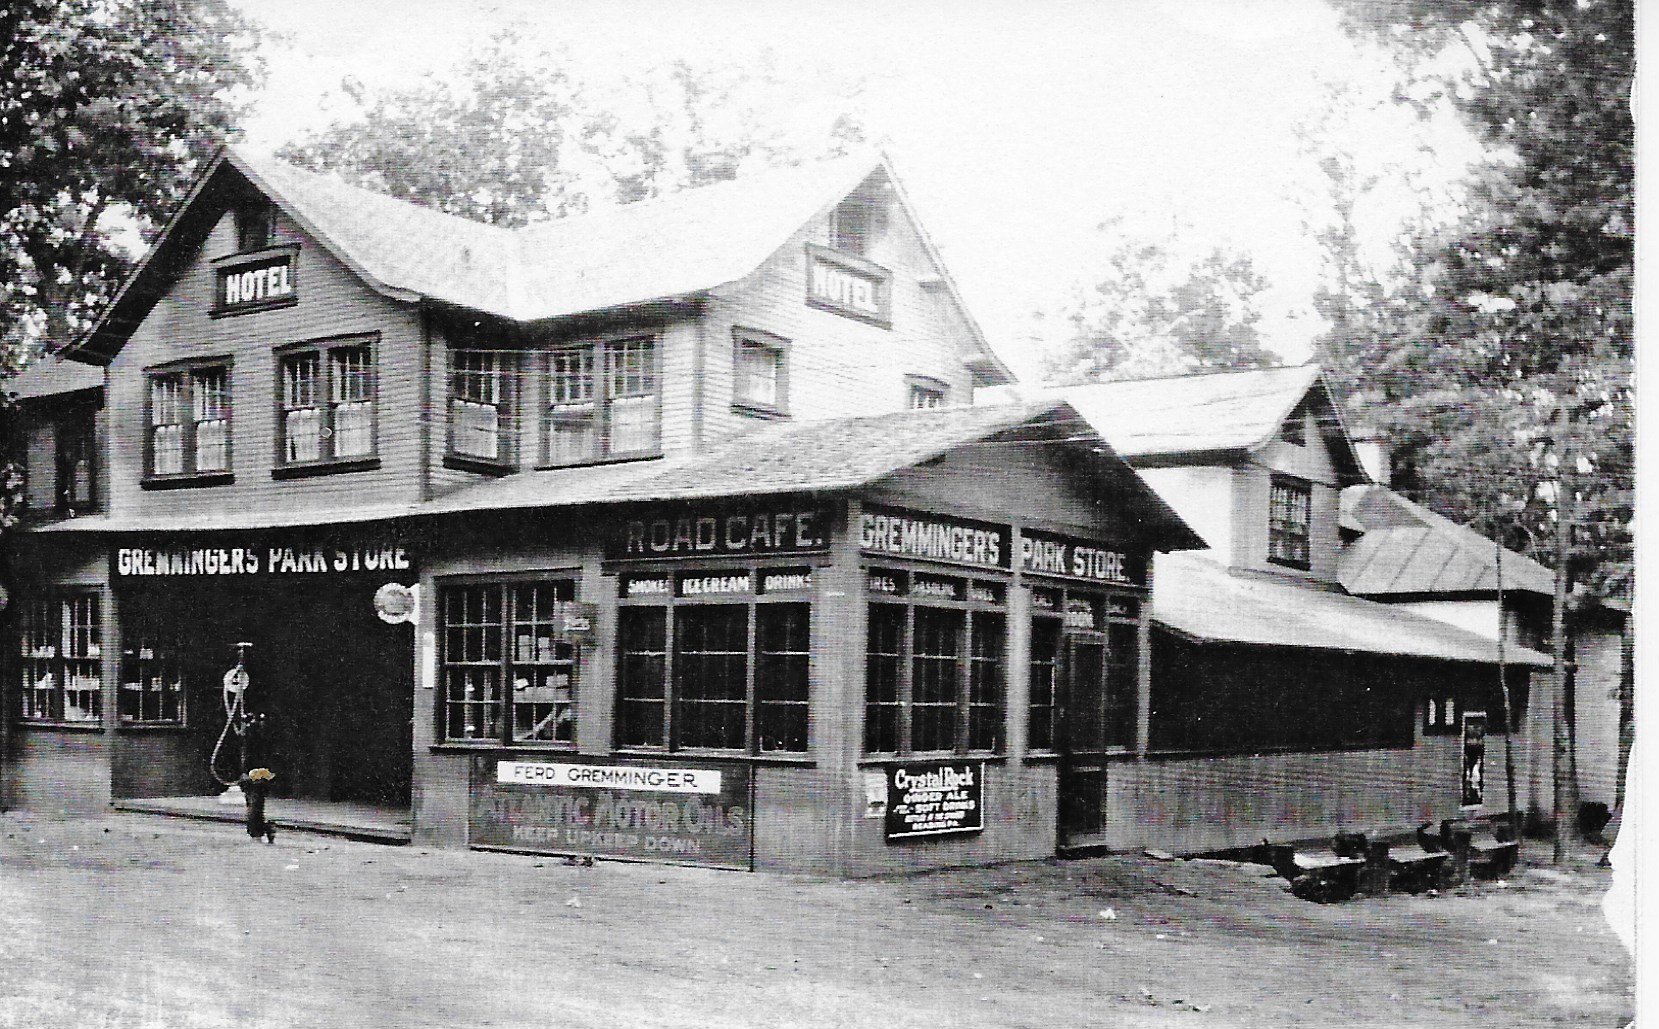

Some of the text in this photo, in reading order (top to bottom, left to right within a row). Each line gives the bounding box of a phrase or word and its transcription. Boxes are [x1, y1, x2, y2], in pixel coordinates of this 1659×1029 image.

[226, 265, 291, 304] HOTEL
[813, 266, 878, 311] HOTEL
[627, 517, 716, 552] ROAD
[268, 548, 328, 572] PARK
[334, 548, 410, 571] STORE
[1021, 537, 1066, 573] PARK
[682, 575, 749, 594] ICE CREAM
[514, 766, 698, 787] FERD GREMMINGER
[895, 766, 974, 790] Crystal Rock
[946, 790, 969, 801] ALE
[477, 790, 744, 836] ATLANTIC MOTOR OILS
[513, 825, 701, 854] KEEP UPKEEP DOWN
